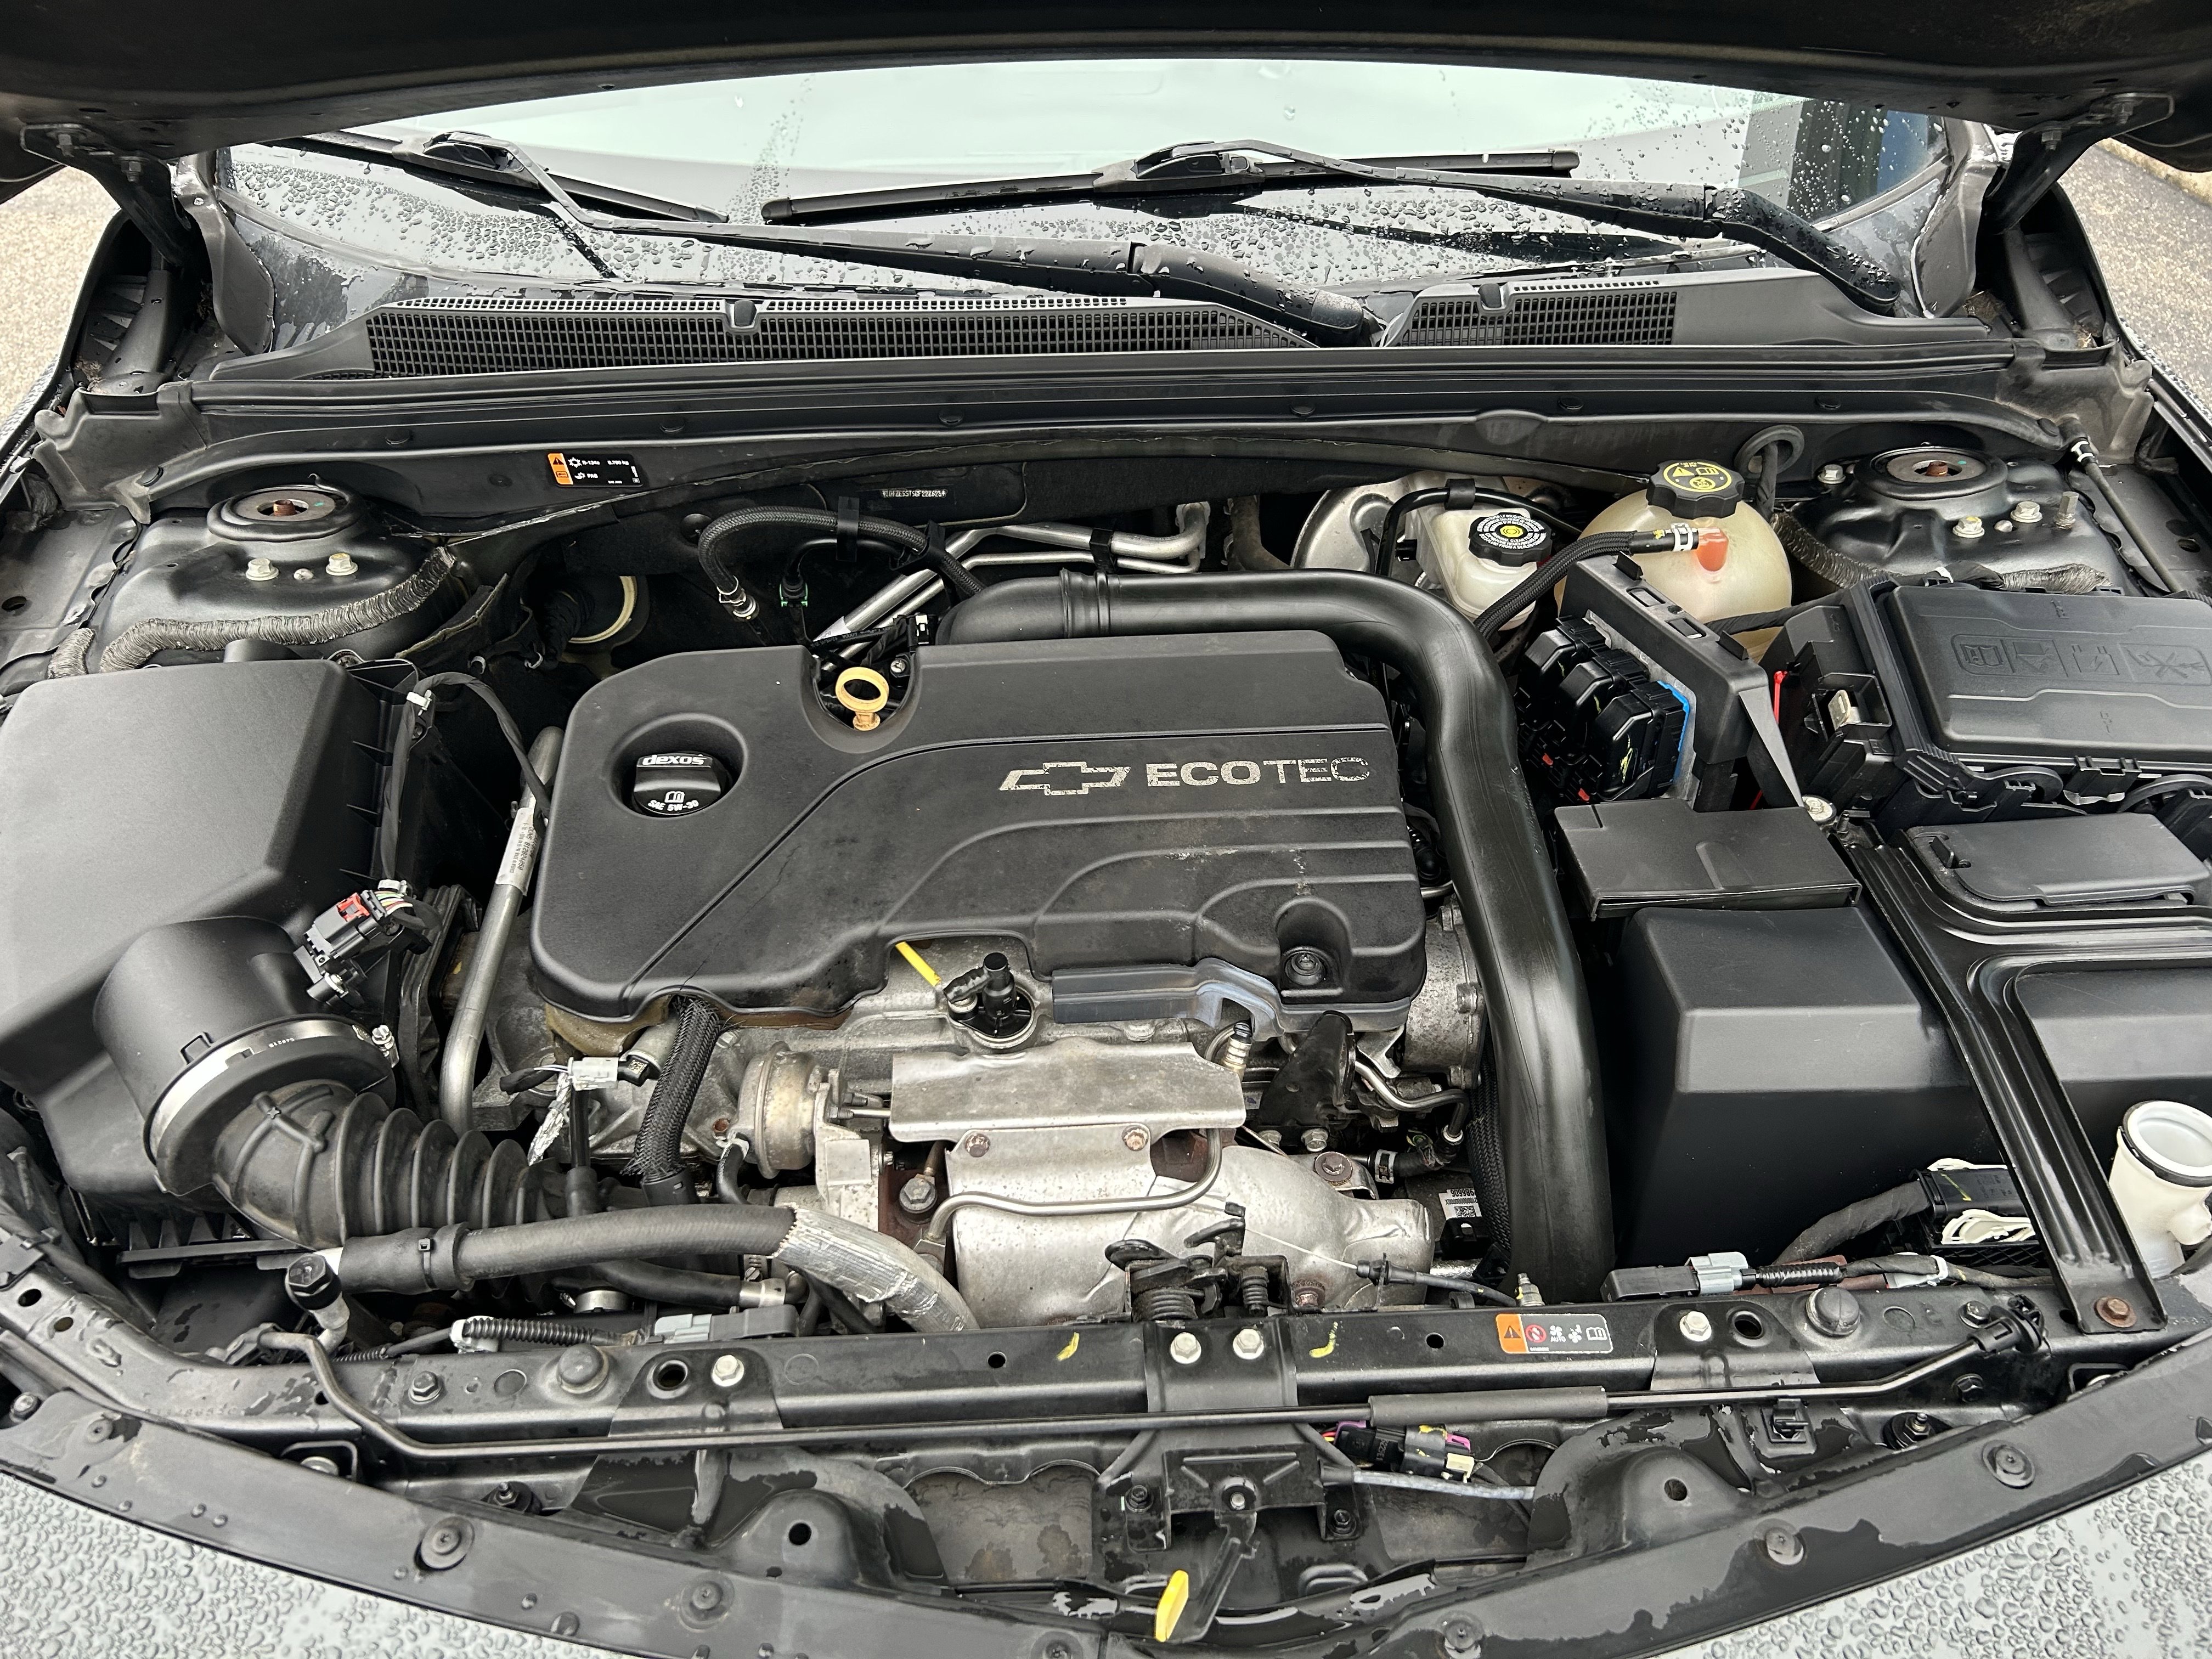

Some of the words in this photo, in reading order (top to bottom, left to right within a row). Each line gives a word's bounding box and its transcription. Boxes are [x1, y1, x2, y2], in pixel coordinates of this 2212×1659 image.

[1147, 757, 1370, 787] ECOTEC
[647, 799, 666, 810] SAE
[667, 799, 699, 811] 5W-30
